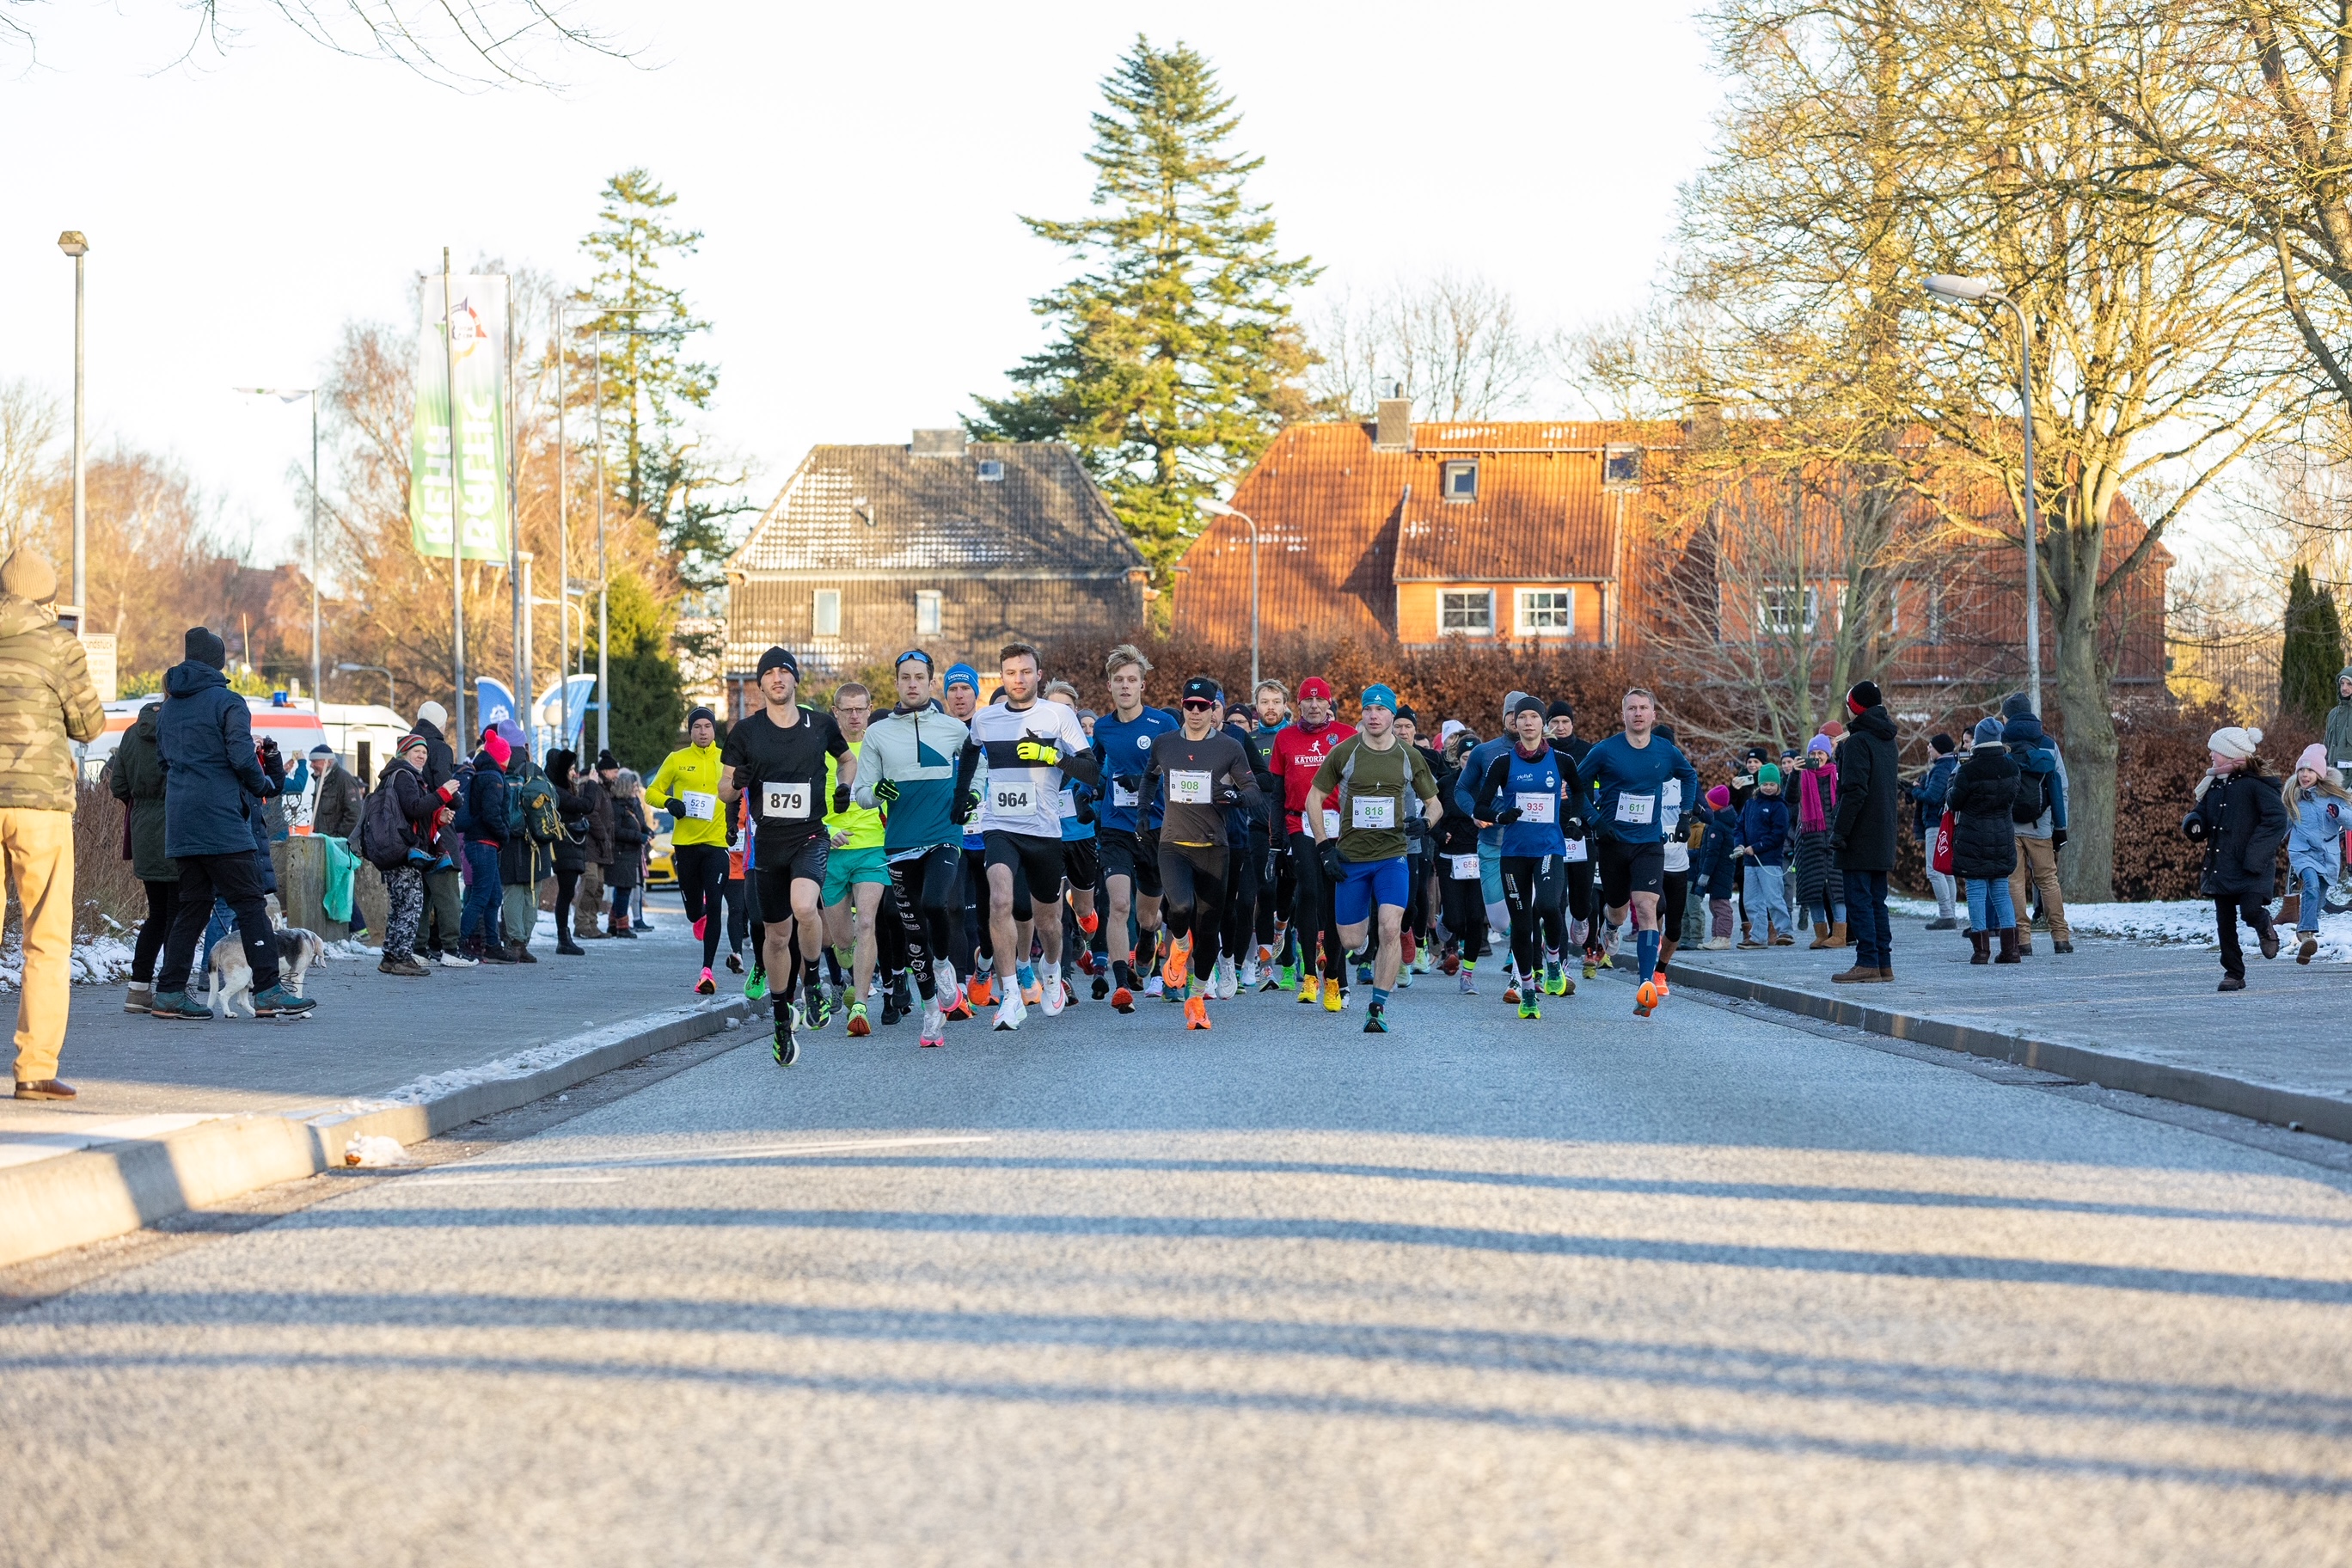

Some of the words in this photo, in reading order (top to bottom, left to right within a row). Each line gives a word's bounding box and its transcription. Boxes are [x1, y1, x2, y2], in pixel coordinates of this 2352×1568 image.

[1180, 781, 1199, 790] 908
[690, 799, 706, 808] 525
[770, 793, 802, 809] 879
[998, 792, 1027, 807] 964
[1365, 806, 1383, 816] 818
[1527, 802, 1544, 811] 935
[1629, 803, 1645, 812] 611
[1463, 861, 1478, 869] 658
